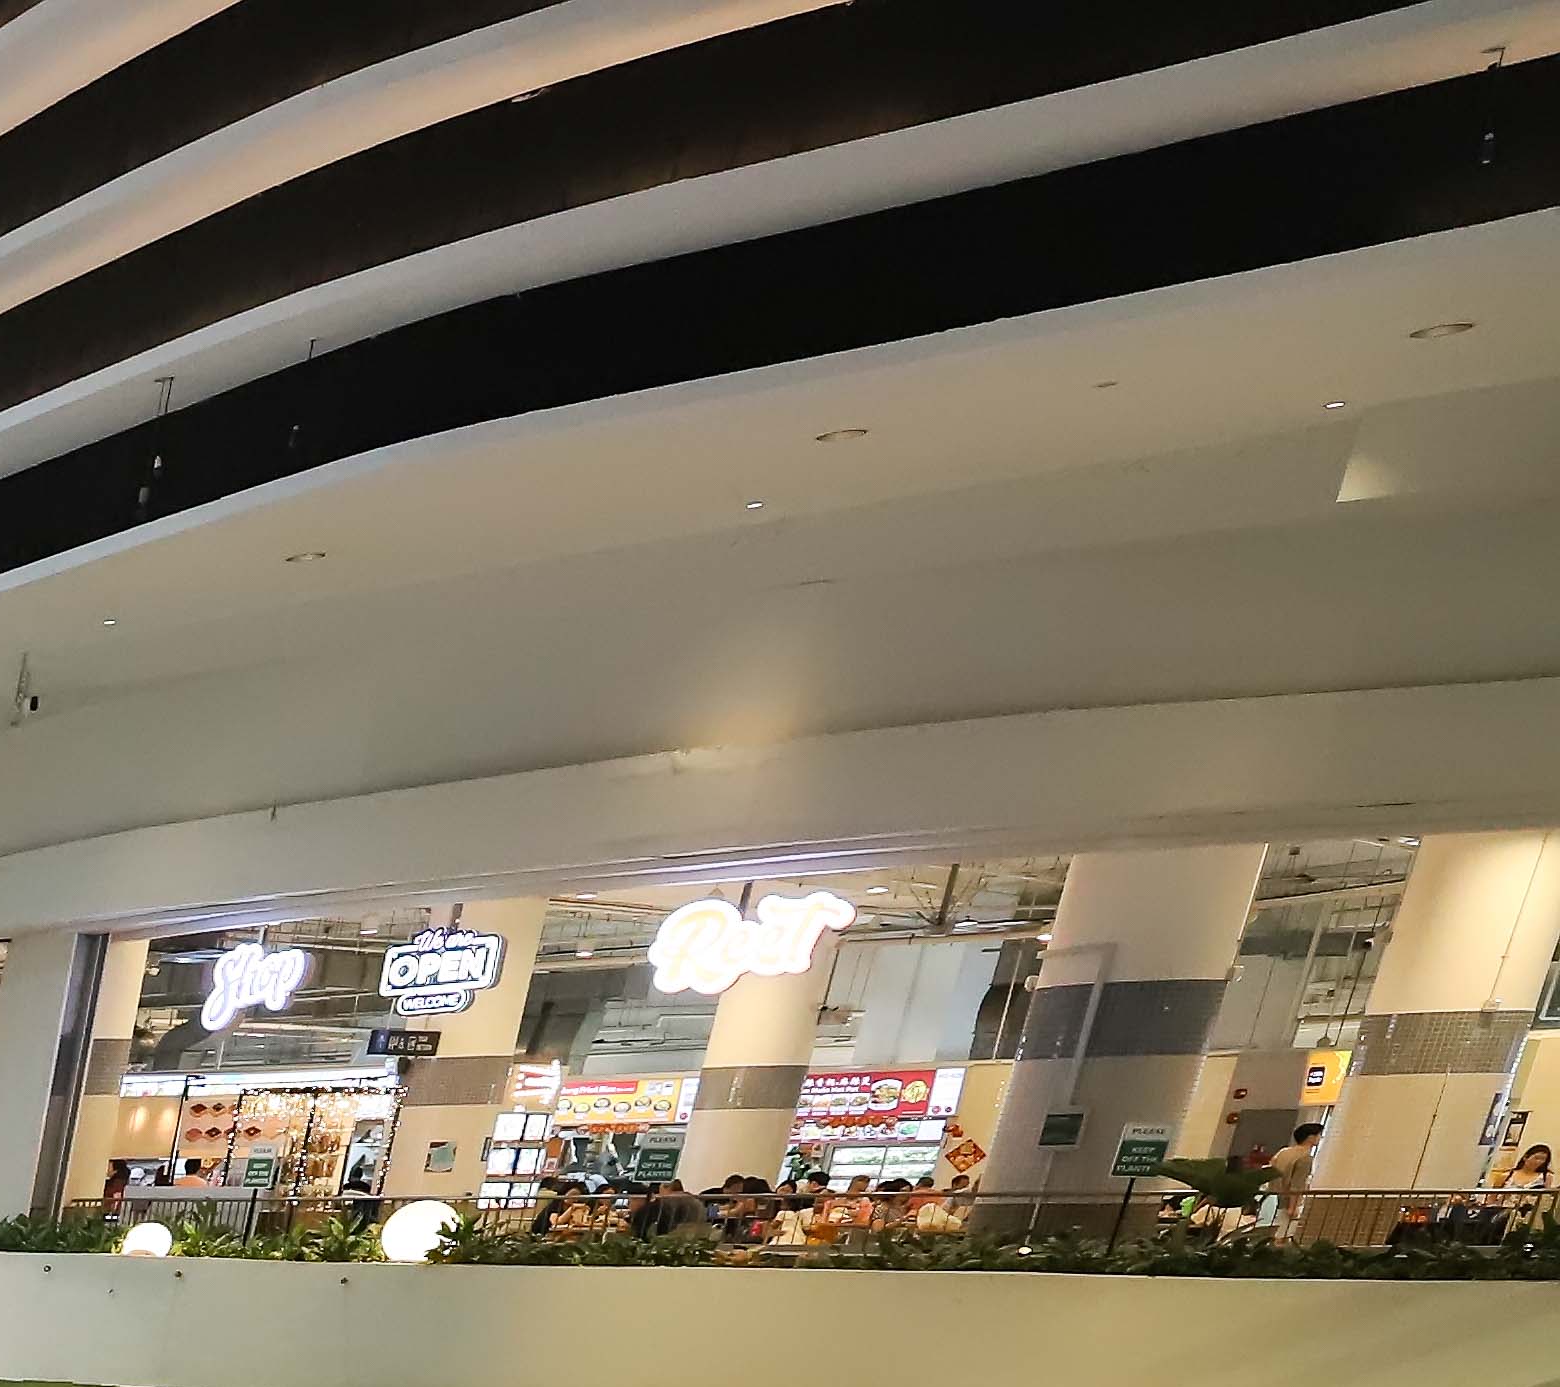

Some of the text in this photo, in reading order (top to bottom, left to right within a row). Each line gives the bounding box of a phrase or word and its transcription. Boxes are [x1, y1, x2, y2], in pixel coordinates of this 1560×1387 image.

[202, 942, 314, 1031] Shop
[386, 948, 488, 988] OPEN
[401, 993, 460, 1011] WELCOME
